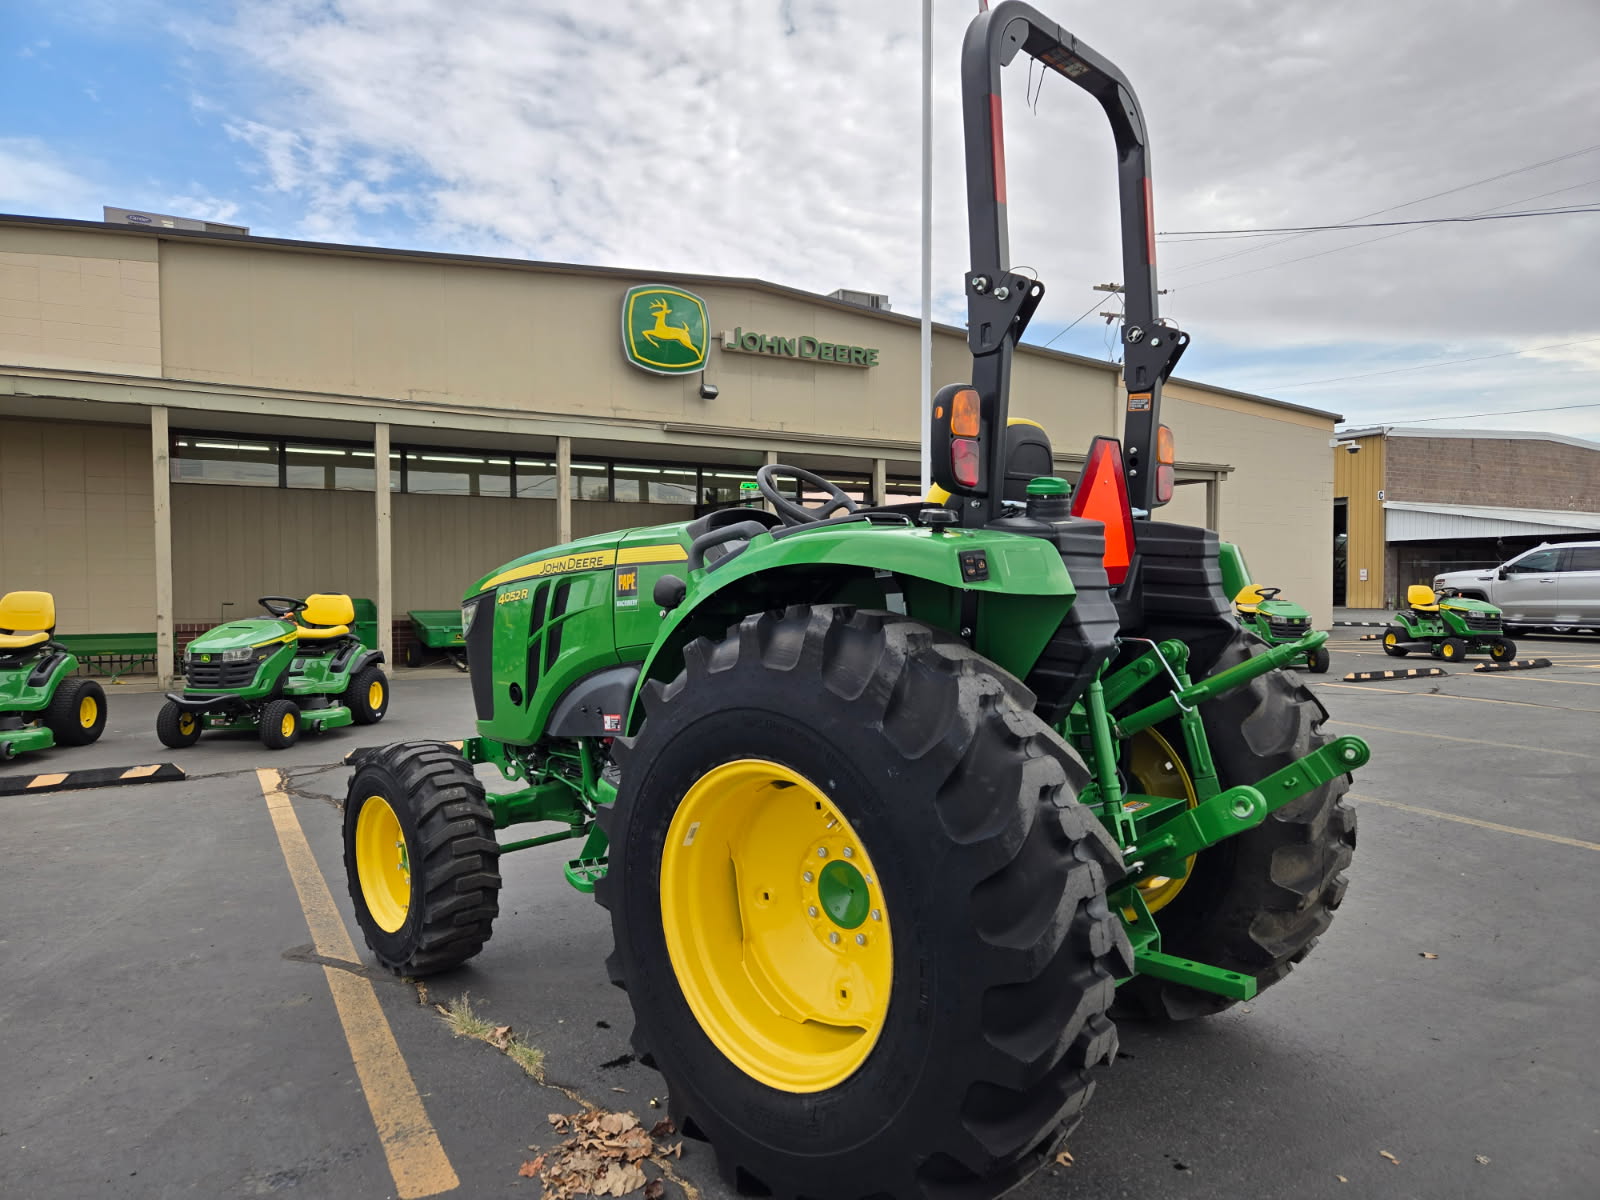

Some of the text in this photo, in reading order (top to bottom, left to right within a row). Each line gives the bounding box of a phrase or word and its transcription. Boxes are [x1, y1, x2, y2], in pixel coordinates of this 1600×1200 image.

[727, 326, 880, 366] JOHN DEERE
[540, 556, 604, 574] JOHN DEERE
[498, 588, 528, 605] 4052R
